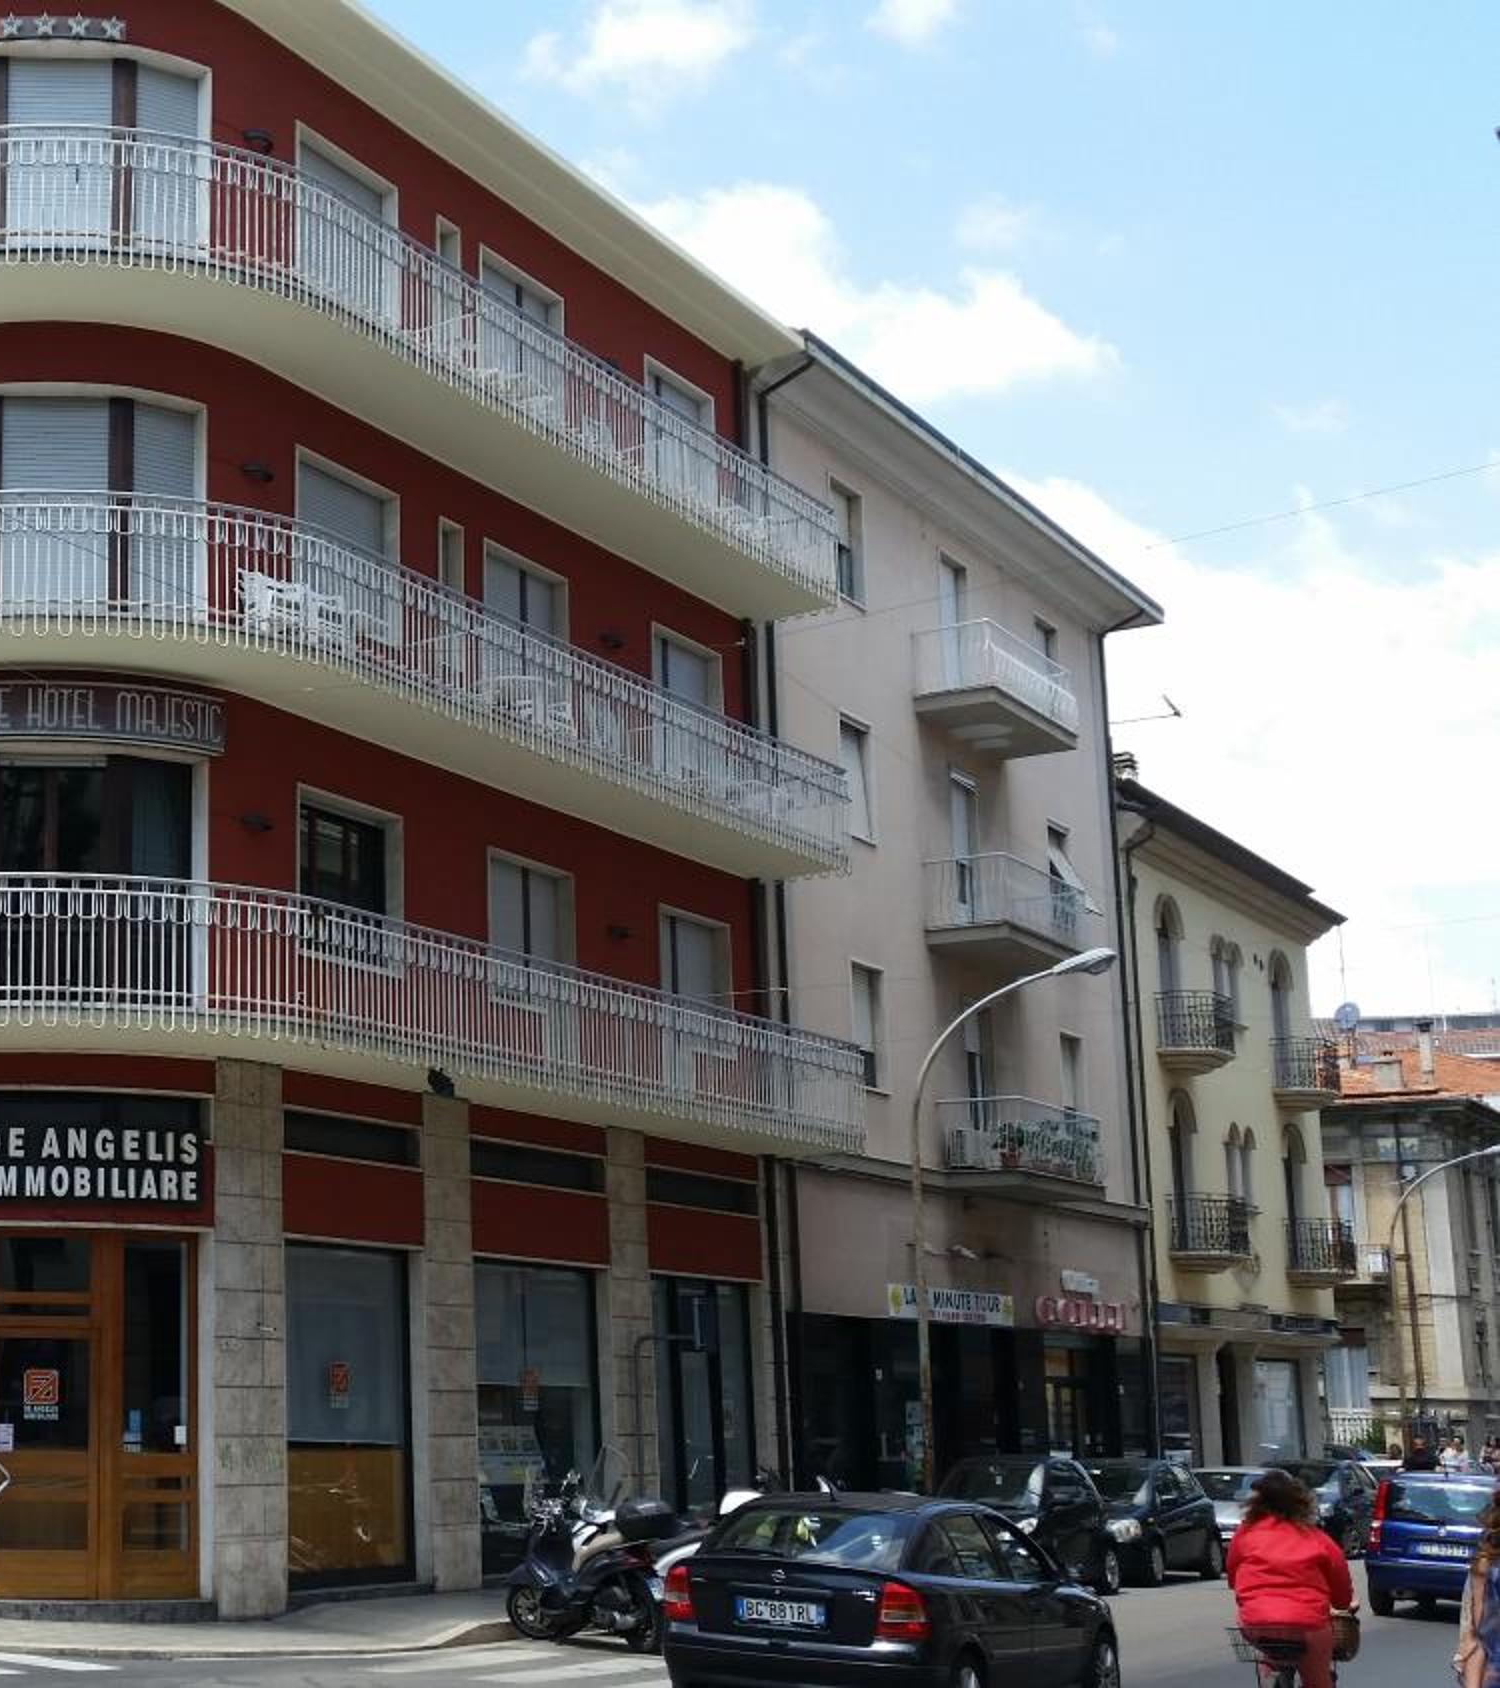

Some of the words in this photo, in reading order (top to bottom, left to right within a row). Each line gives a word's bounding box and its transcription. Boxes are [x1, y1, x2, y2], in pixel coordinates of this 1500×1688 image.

[27, 686, 103, 732] HOTEL
[115, 689, 224, 743] MAJESTIC
[40, 1127, 198, 1165] ANGELIS
